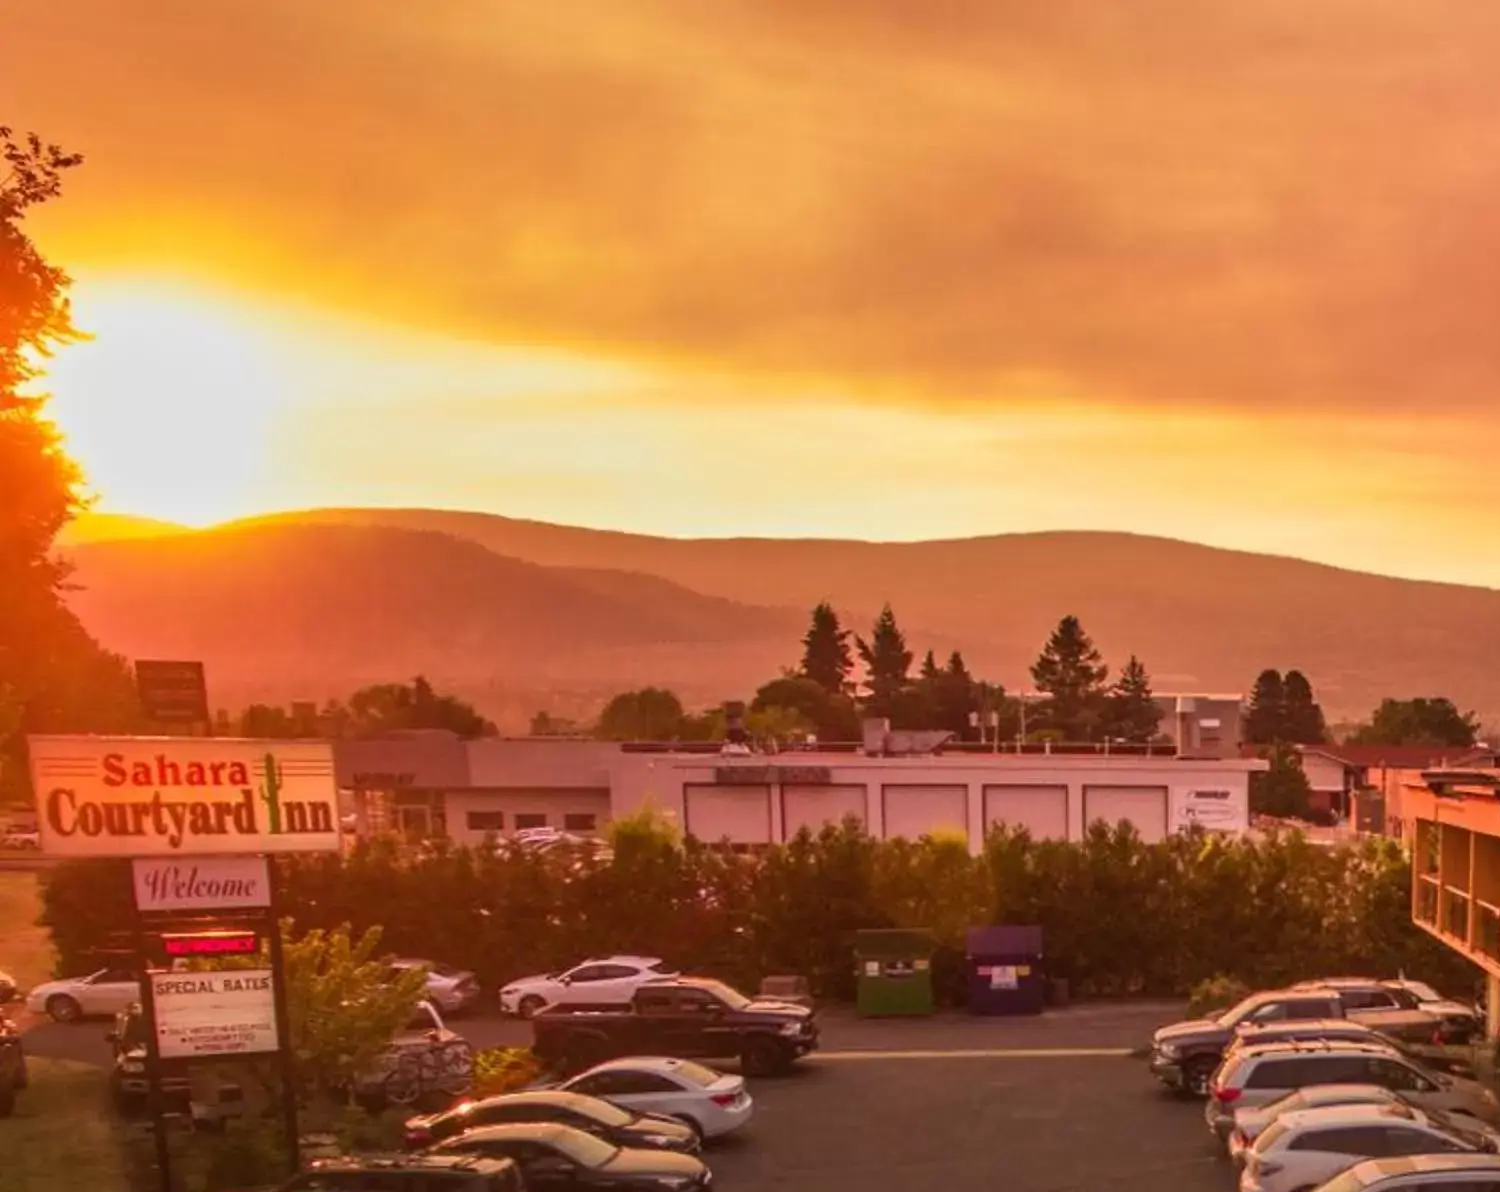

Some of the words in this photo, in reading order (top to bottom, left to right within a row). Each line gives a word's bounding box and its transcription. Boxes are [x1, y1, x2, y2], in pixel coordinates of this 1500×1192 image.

[102, 753, 250, 787] Sahara
[47, 788, 259, 849] Courtyard
[144, 865, 257, 902] Welcome
[156, 980, 215, 995] SPECIAL
[223, 977, 271, 992] RATES
